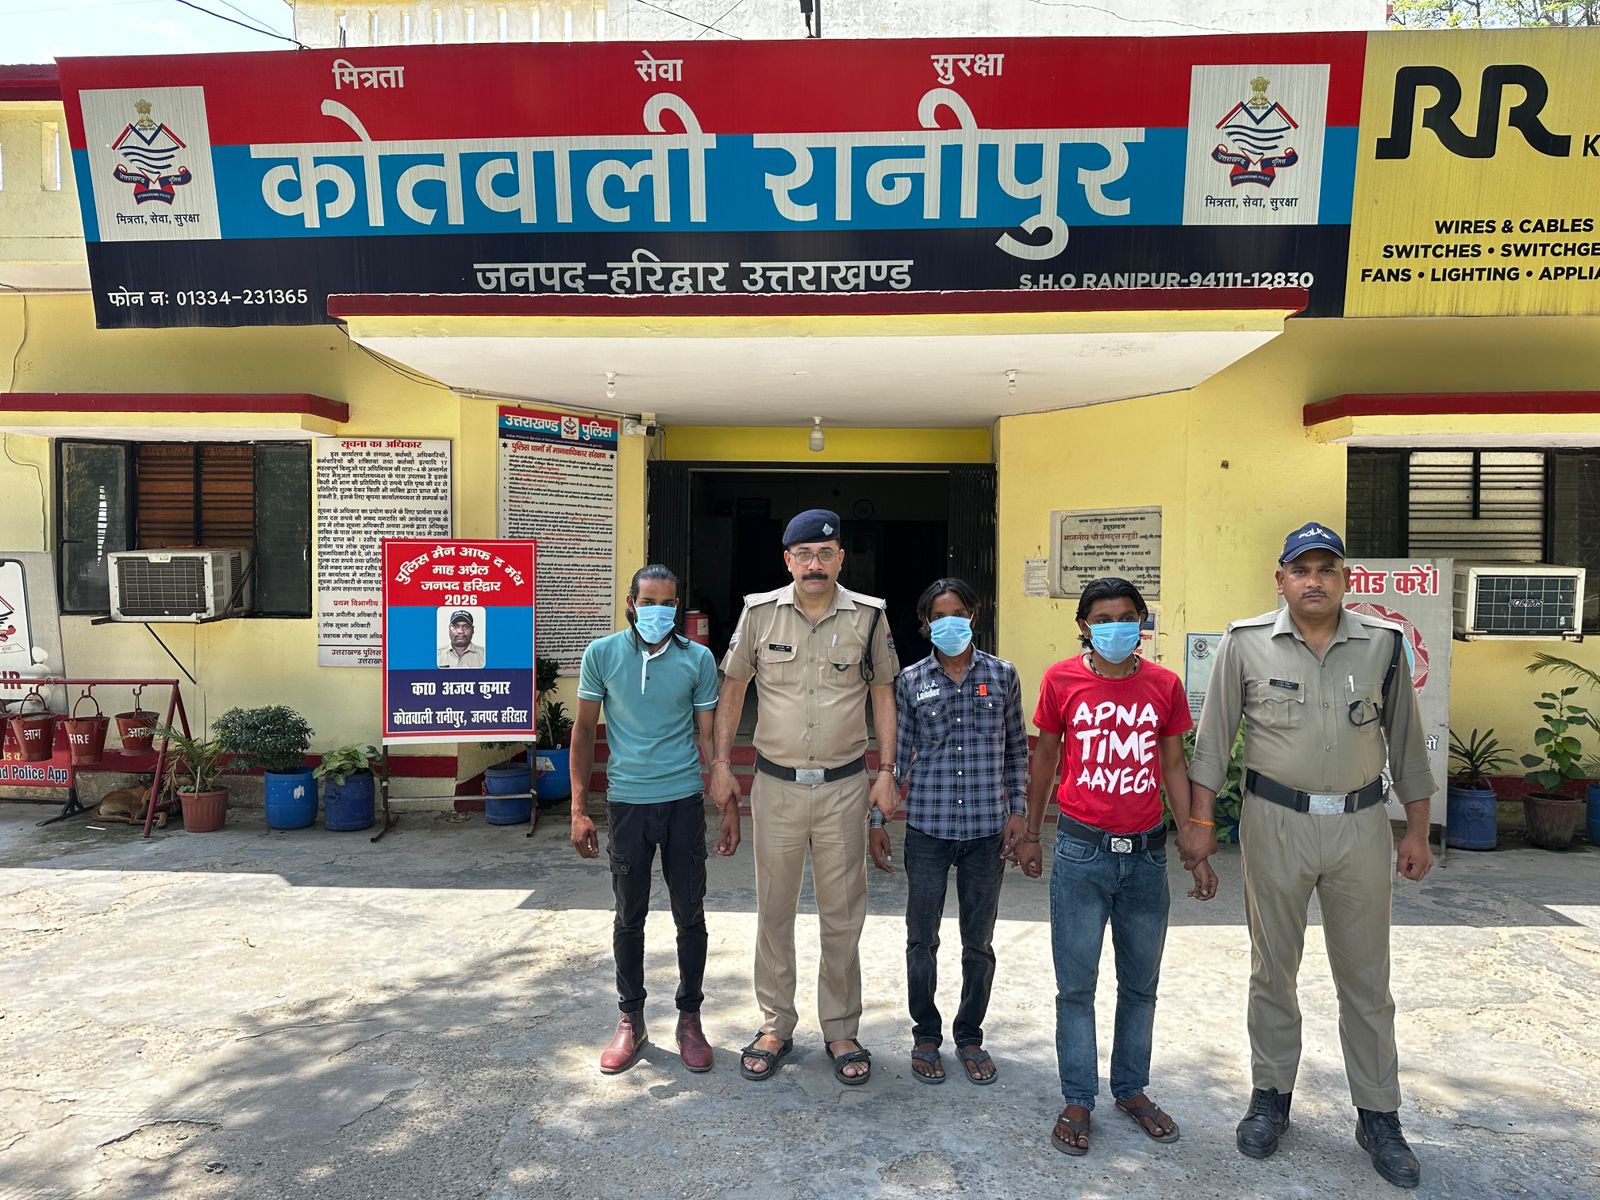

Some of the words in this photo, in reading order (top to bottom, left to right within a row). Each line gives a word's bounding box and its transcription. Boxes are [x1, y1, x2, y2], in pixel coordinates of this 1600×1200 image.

[332, 58, 404, 89] मित्रता
[634, 49, 683, 82] सेवा
[931, 53, 1004, 84] सुरक्षा
[1375, 64, 1571, 159] RR
[250, 92, 716, 228] कोतवाली
[753, 87, 1145, 260] रानीपुर
[1205, 195, 1238, 209] मित्रता,
[1242, 194, 1265, 208] सेवा,
[1269, 197, 1298, 211] सुरक्षा
[116, 213, 147, 225] मित्रता,
[150, 211, 172, 224] सेवा,
[174, 213, 200, 226] सुरक्षा
[1434, 220, 1497, 234] WIRES
[1501, 219, 1514, 234] &
[1519, 218, 1594, 233] CABLES
[1382, 243, 1482, 259] SWITCHES
[1500, 242, 1600, 257] SWITCHGE
[473, 248, 729, 294] जनपद-हरिद्वार
[740, 260, 914, 291] उत्तराखण्ड
[1360, 268, 1412, 282] FANS
[1430, 267, 1520, 282] LIGHTING
[1019, 273, 1076, 290] S.H.O
[1082, 271, 1314, 289] RANIPUR-94111-12830
[107, 286, 144, 307] फोन
[176, 289, 308, 306] 01334-231365
[504, 414, 560, 432] उत्तराखण्ड
[581, 421, 613, 441] पुलिस
[341, 440, 367, 450] सूचना
[370, 440, 382, 448] का
[385, 439, 423, 449] अधिकार
[395, 552, 430, 585] पुलिस
[459, 547, 492, 561] आफ
[493, 556, 506, 568] द
[432, 565, 455, 576] माह
[420, 581, 461, 591] जनपद
[463, 578, 502, 592] हरिद्वार
[444, 594, 478, 606] 2026
[442, 681, 476, 695] अजय
[478, 681, 511, 699] कुमार
[393, 707, 434, 725] कोतवाली
[435, 707, 468, 728] रानीपुर,
[470, 710, 499, 723] जनपद
[500, 707, 528, 723] हरिद्वार
[1072, 701, 1159, 729] APNA
[23, 729, 42, 741] आग
[12, 764, 44, 780] Police
[48, 766, 68, 784] App
